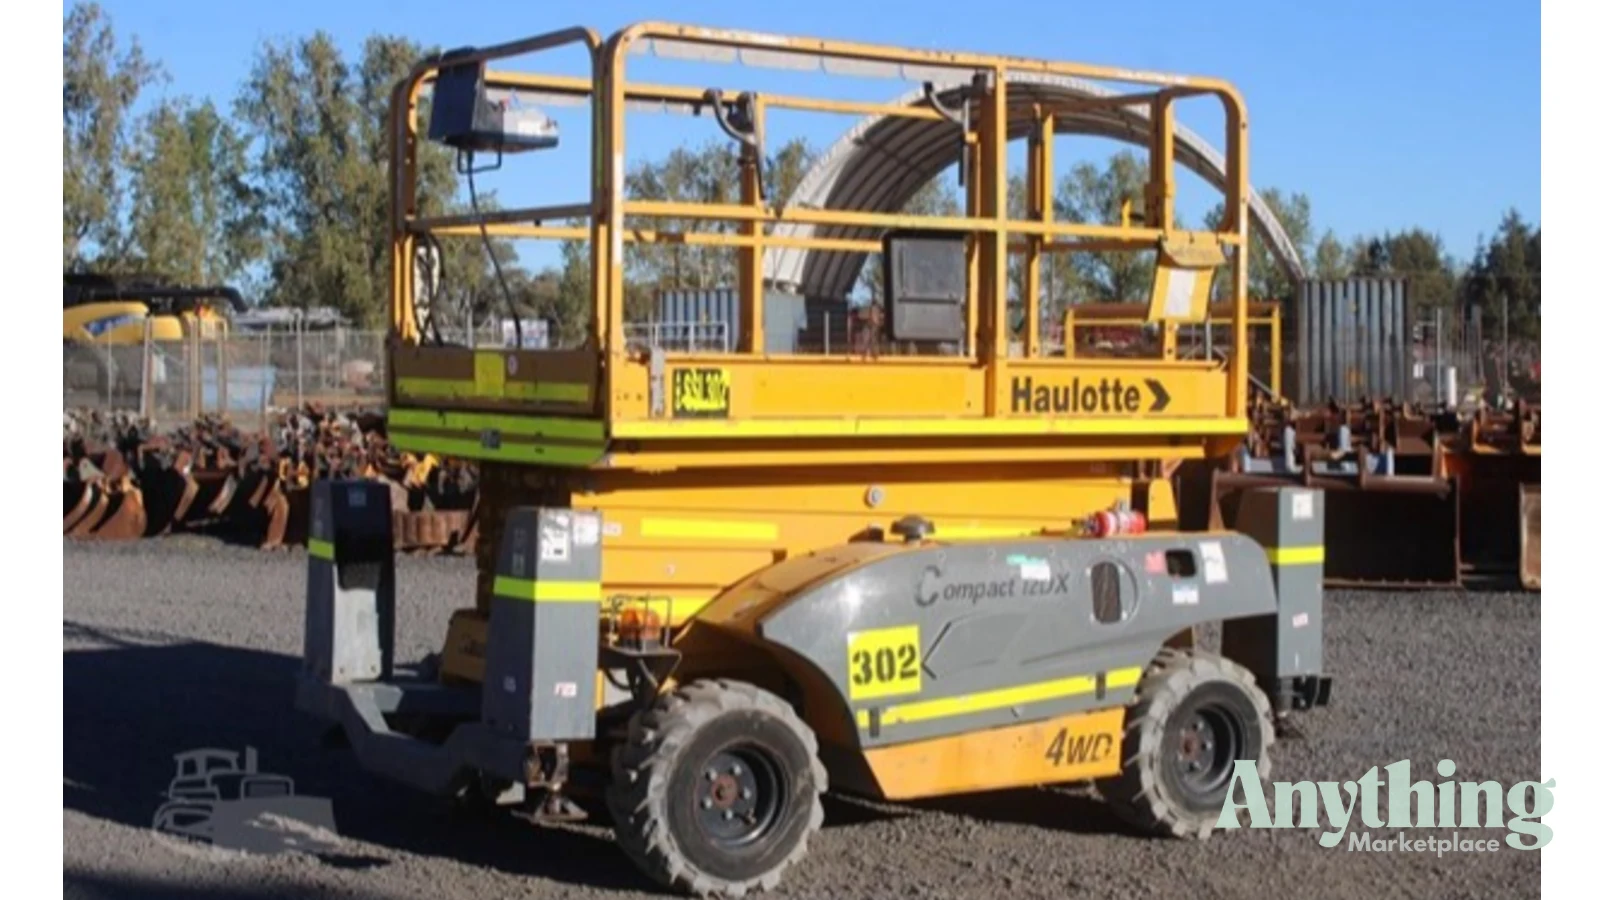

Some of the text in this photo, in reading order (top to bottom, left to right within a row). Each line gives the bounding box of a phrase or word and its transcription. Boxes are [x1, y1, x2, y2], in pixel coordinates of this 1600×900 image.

[1011, 375, 1141, 413] Haulotte
[914, 564, 1015, 607] Compact
[852, 643, 919, 686] 302
[1044, 726, 1114, 768] 4WD
